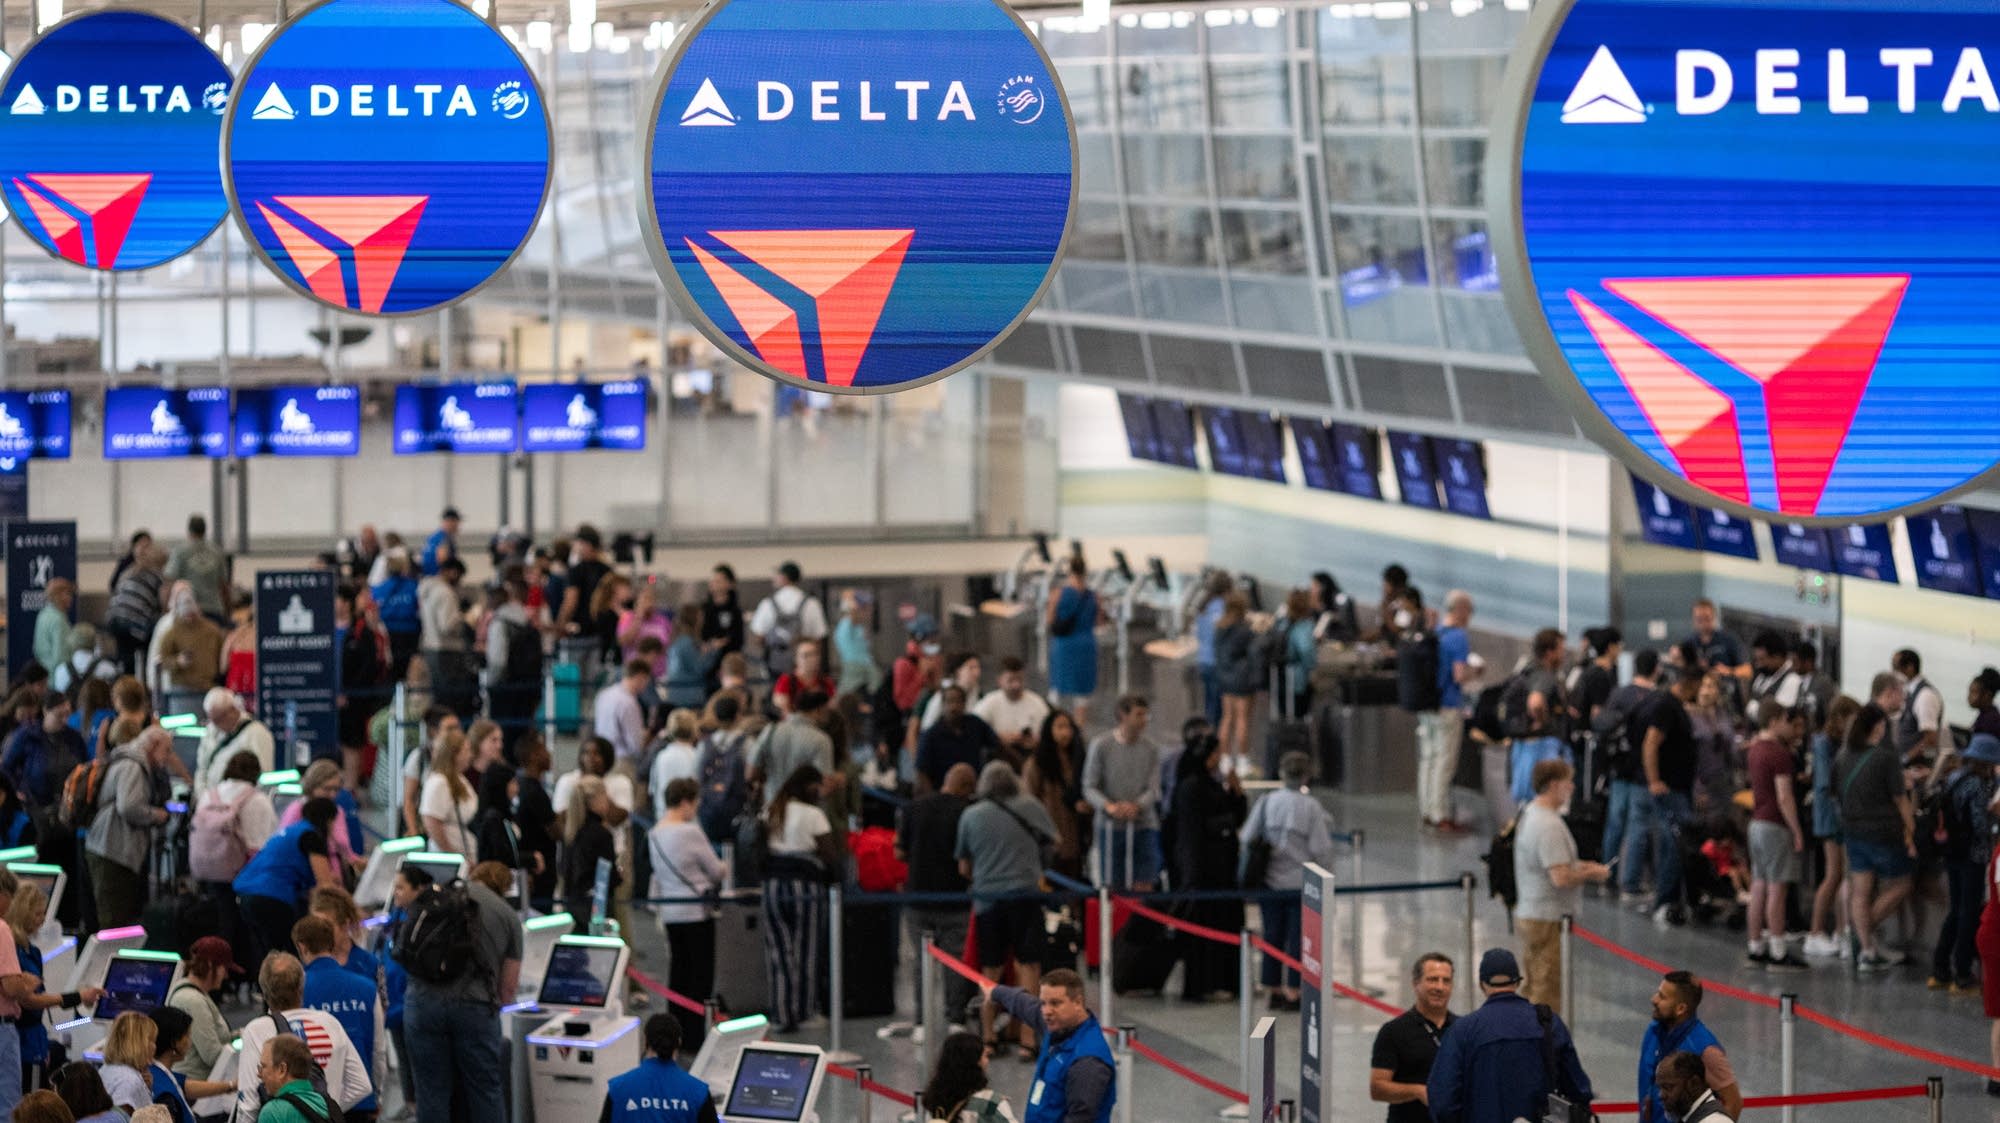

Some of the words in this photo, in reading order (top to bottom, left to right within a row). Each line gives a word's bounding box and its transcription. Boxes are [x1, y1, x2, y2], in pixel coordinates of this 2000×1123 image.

[997, 75, 1034, 115] SKYTEAM
[1675, 47, 2000, 115] DELTA
[56, 84, 191, 113] DELTA
[310, 84, 477, 116] DELTA
[757, 80, 976, 121] DELTA
[321, 999, 368, 1013] DELTA
[641, 1097, 689, 1111] DELTA
